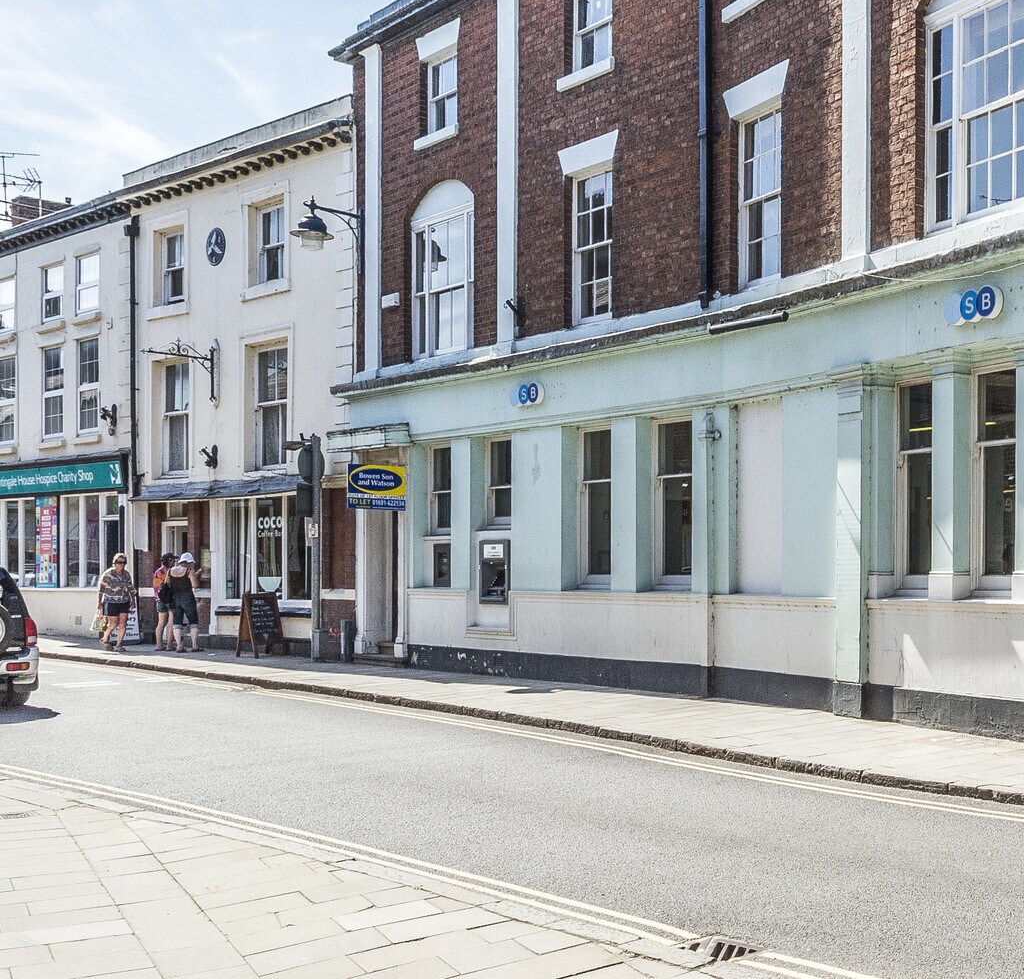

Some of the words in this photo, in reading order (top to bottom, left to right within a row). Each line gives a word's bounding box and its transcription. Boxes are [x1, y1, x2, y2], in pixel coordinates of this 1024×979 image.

[17, 475, 36, 486] House
[35, 473, 58, 487] Hospice
[57, 470, 78, 485] Charity
[77, 469, 94, 484] Shop
[358, 472, 380, 480] Bowen
[258, 516, 282, 529] COCO
